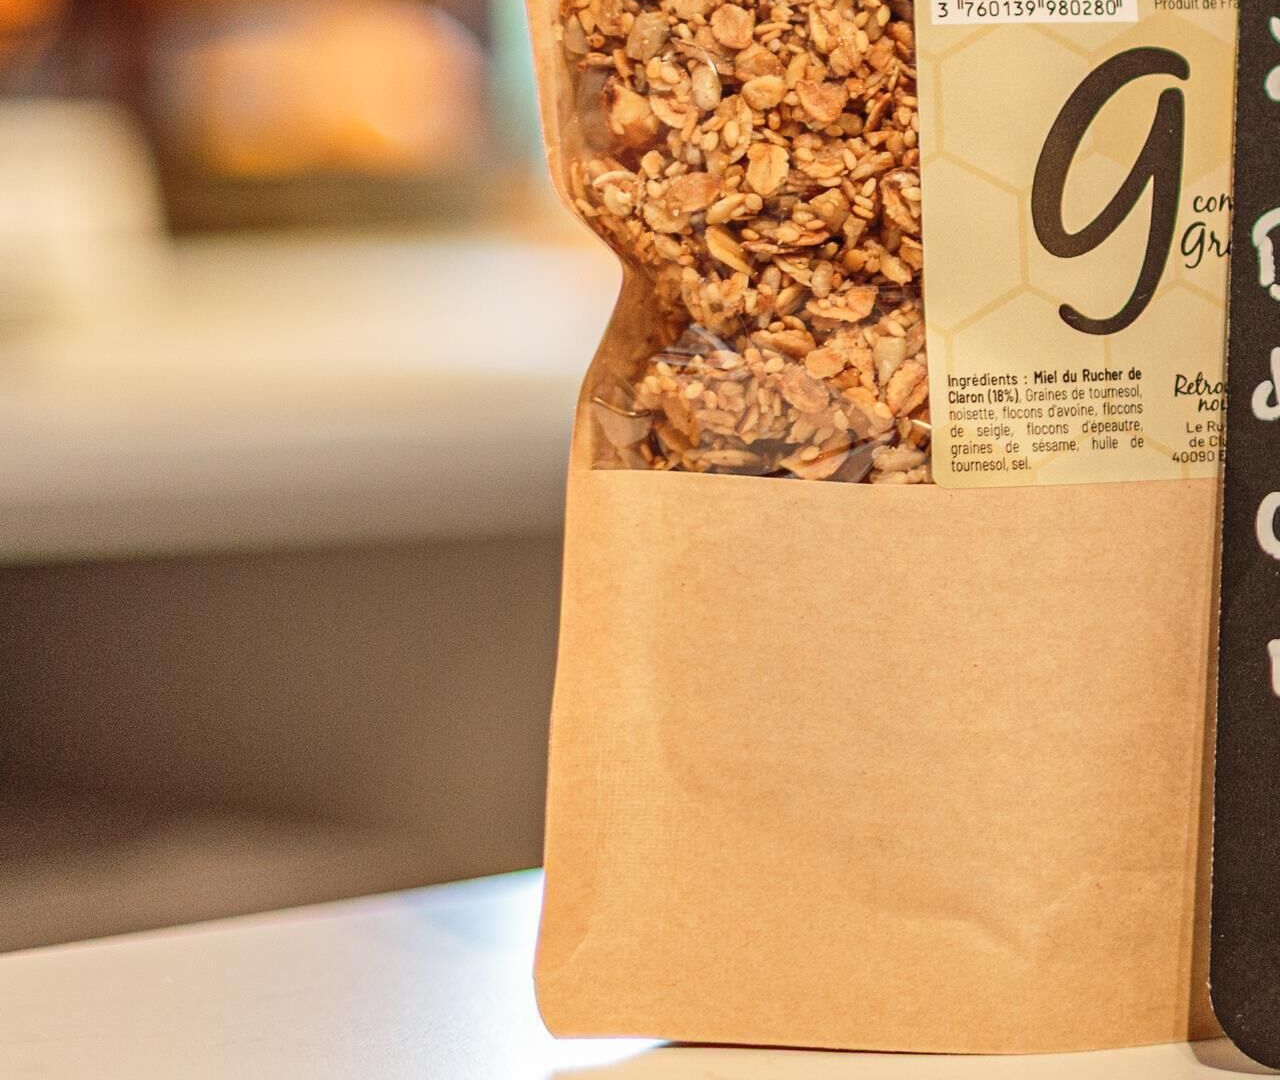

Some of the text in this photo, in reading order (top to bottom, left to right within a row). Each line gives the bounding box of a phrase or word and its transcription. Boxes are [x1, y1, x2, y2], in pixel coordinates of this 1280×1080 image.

[938, 2, 1116, 18] 3 760139 980280
[948, 374, 1018, 390] Ingrédients
[1034, 371, 1057, 384] Miel
[1063, 370, 1077, 383] du
[1082, 369, 1123, 382] Rucher
[1128, 367, 1142, 380] de
[1174, 371, 1228, 397] Retro
[948, 384, 1142, 405] Claron (18%), Graines de tournesol,
[949, 402, 1144, 421] noisette, flocons d'avoine, flocons
[950, 425, 964, 438] de
[977, 424, 1014, 440] seigle,
[1027, 422, 1069, 435] flocons
[1186, 420, 1224, 433] Le Ru
[951, 435, 1144, 458] graines de sésame, huile de
[1189, 436, 1205, 448] de
[951, 456, 1032, 472] tournesol, sel.
[1172, 451, 1215, 463] 40090
